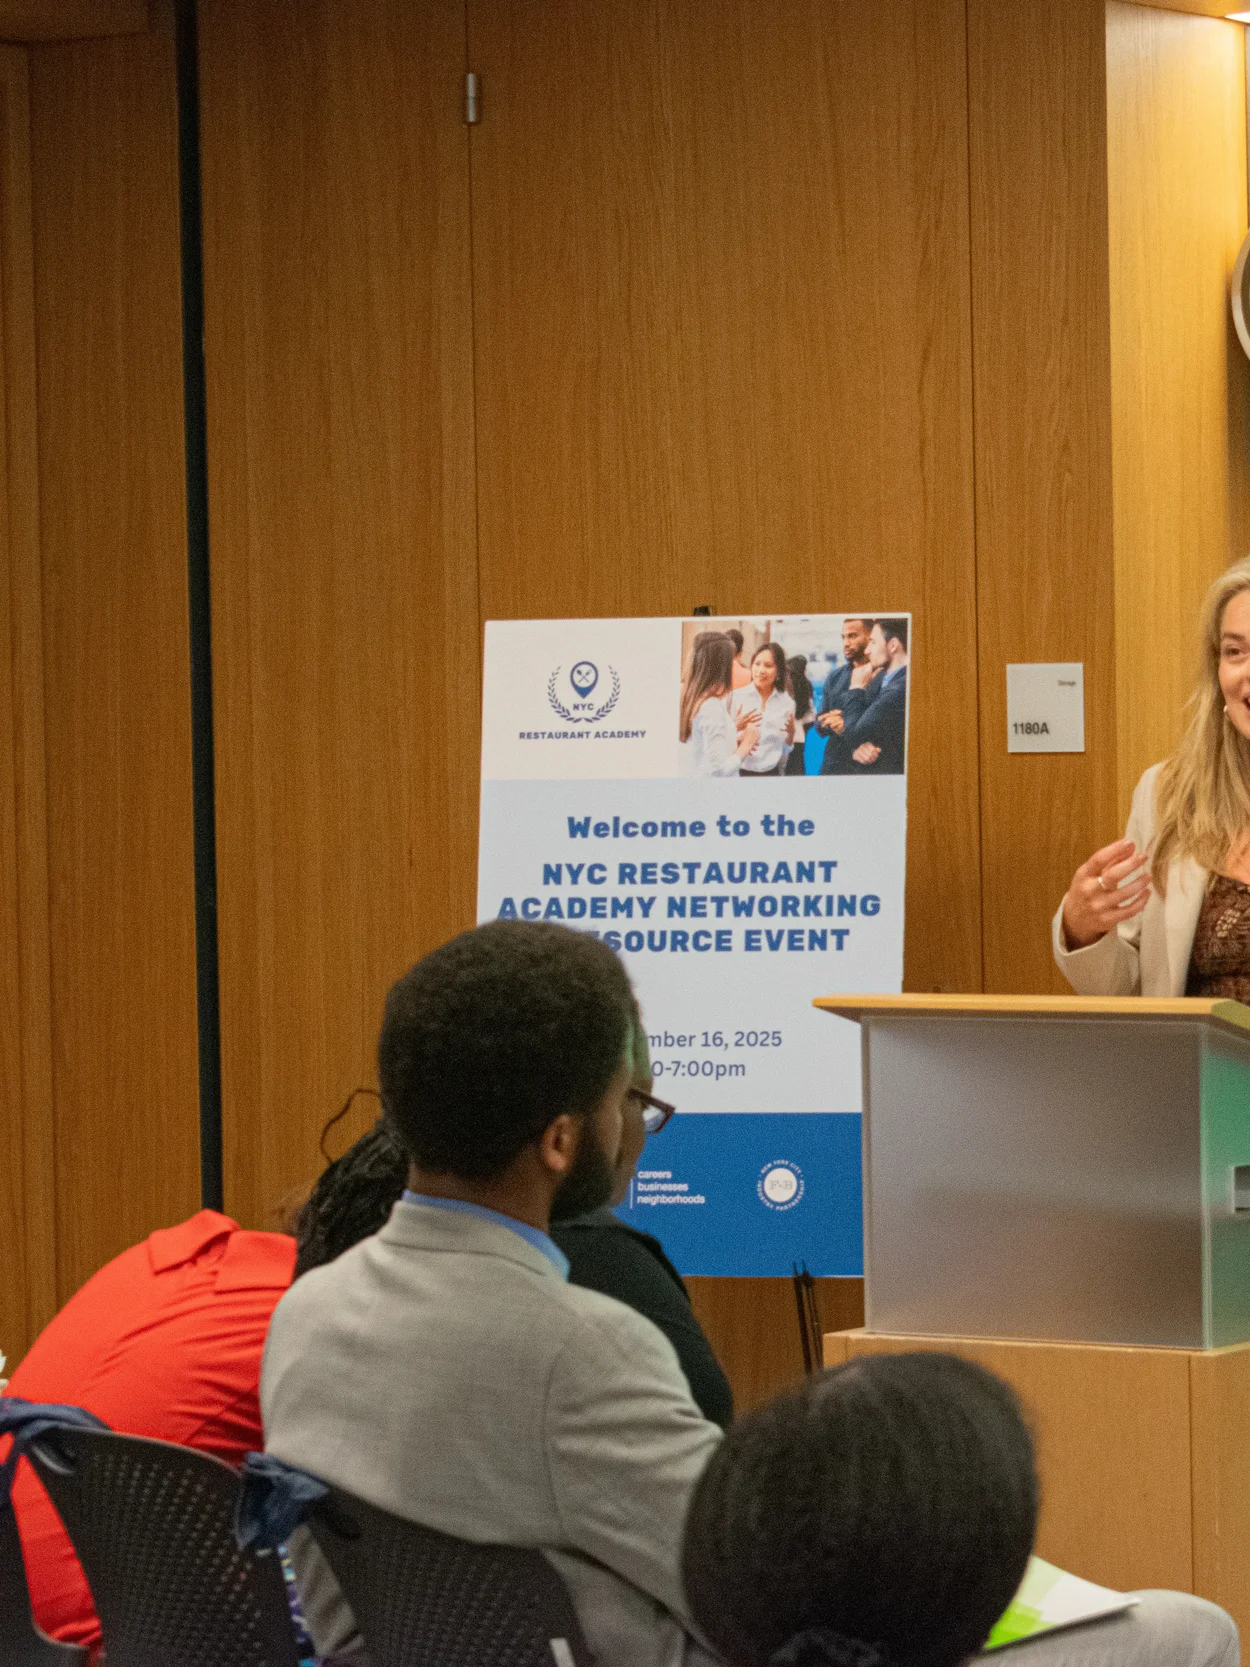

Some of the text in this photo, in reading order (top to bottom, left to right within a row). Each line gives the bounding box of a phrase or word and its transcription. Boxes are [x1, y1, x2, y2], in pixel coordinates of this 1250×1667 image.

[572, 703, 595, 711] NYC
[518, 730, 647, 740] RESTAURANT ACADEMY
[1013, 722, 1050, 735] 1180A
[567, 814, 815, 839] Welcome to the
[543, 860, 838, 886] NYC RESTAURANT
[497, 894, 881, 920] ACADEMY NETWORKING
[587, 929, 850, 953] SOURCE EVENT
[648, 1030, 782, 1051] mber 16, 2025
[651, 1060, 746, 1081] 0-7:00pm
[637, 1170, 672, 1179] careers
[637, 1182, 689, 1192] businesses
[637, 1194, 706, 1206] neighborhoods
